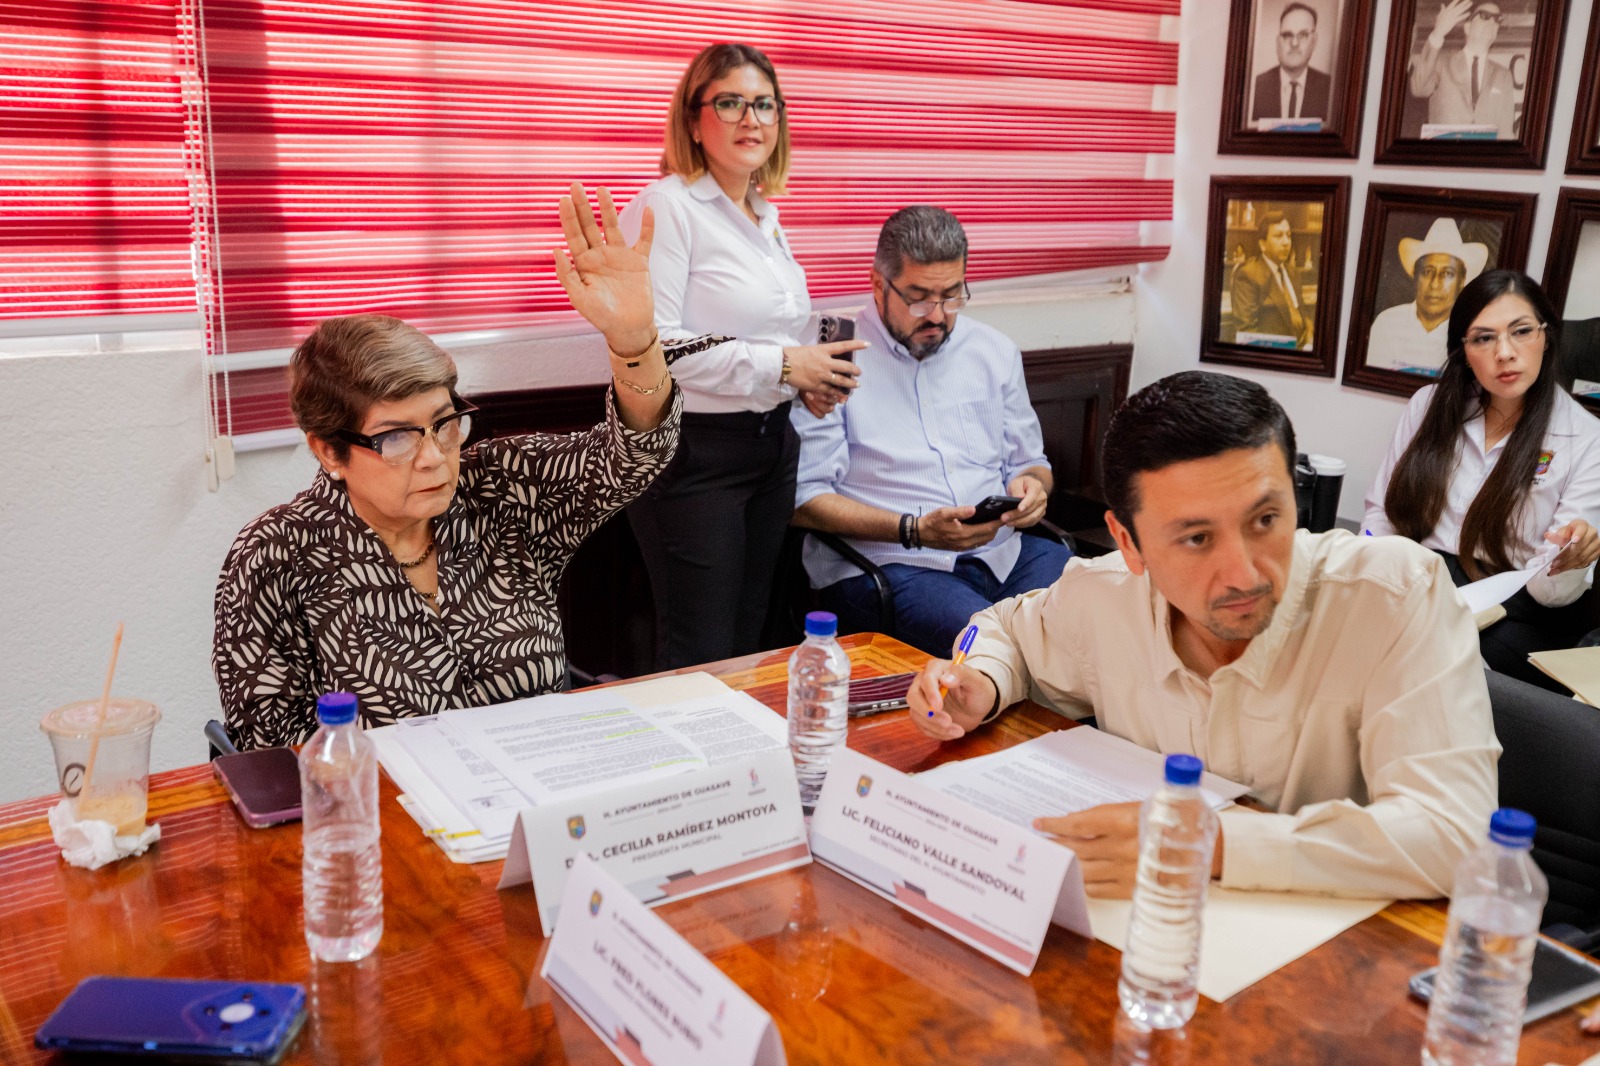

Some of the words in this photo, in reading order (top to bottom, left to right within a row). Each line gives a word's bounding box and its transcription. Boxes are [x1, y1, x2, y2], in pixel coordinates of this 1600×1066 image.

[614, 793, 680, 817] AYUNTAMIENTO
[681, 788, 692, 798] DE
[693, 780, 732, 796] GUASAVE
[603, 836, 653, 858] CECILIA
[657, 819, 714, 843] RAMÍREZ
[717, 802, 777, 826] MONTOYA
[632, 844, 680, 863] PRESIDENTA
[681, 833, 723, 851] MUNICIPAL
[842, 805, 861, 825] LIC.
[863, 817, 920, 850] FELICIANO
[922, 844, 958, 868] VALLE
[960, 861, 1026, 902] SANDOVAL
